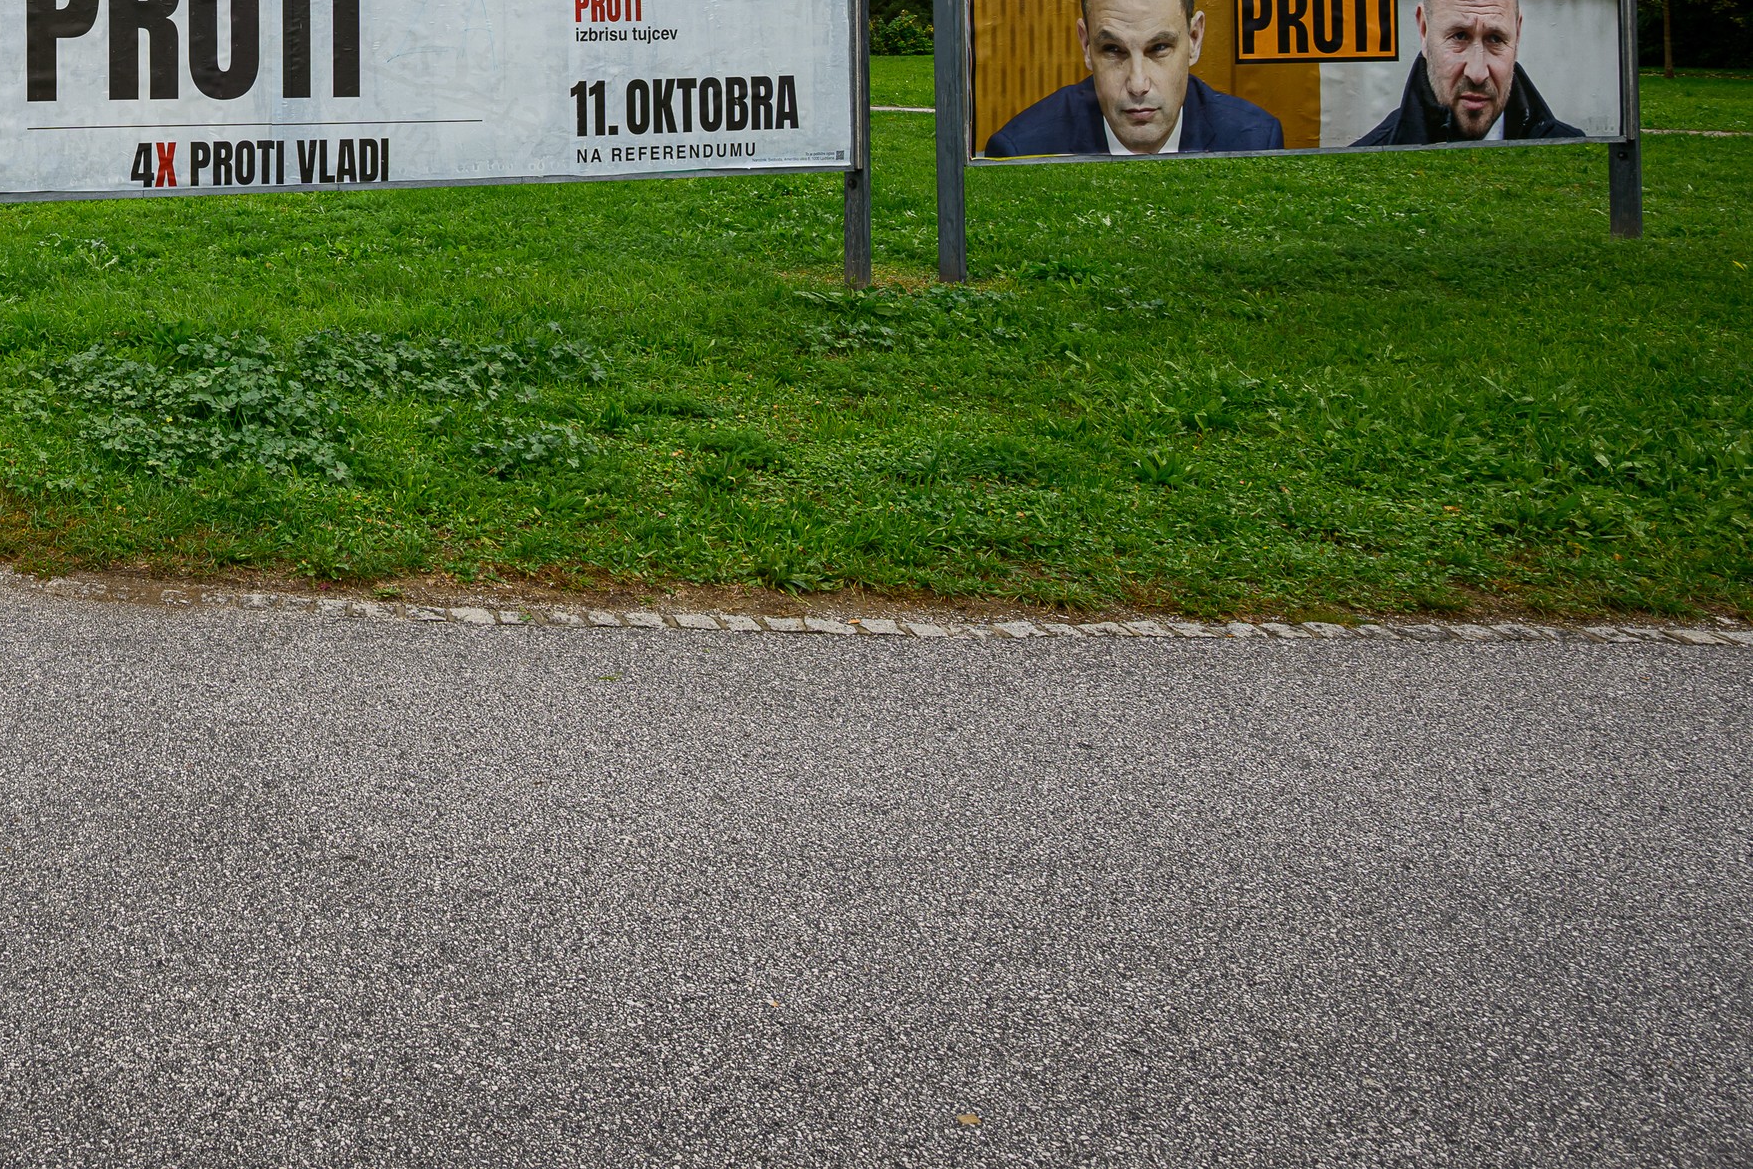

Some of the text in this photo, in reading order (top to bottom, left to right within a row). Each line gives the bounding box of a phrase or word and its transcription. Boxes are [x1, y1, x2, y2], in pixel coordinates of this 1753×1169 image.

[575, 27, 678, 45] izbrisu tujcev
[570, 75, 800, 137] 11. OKTOBRA
[130, 137, 390, 188] 4X PROTI VLADI
[576, 142, 756, 164] NA REFERENDUMU
